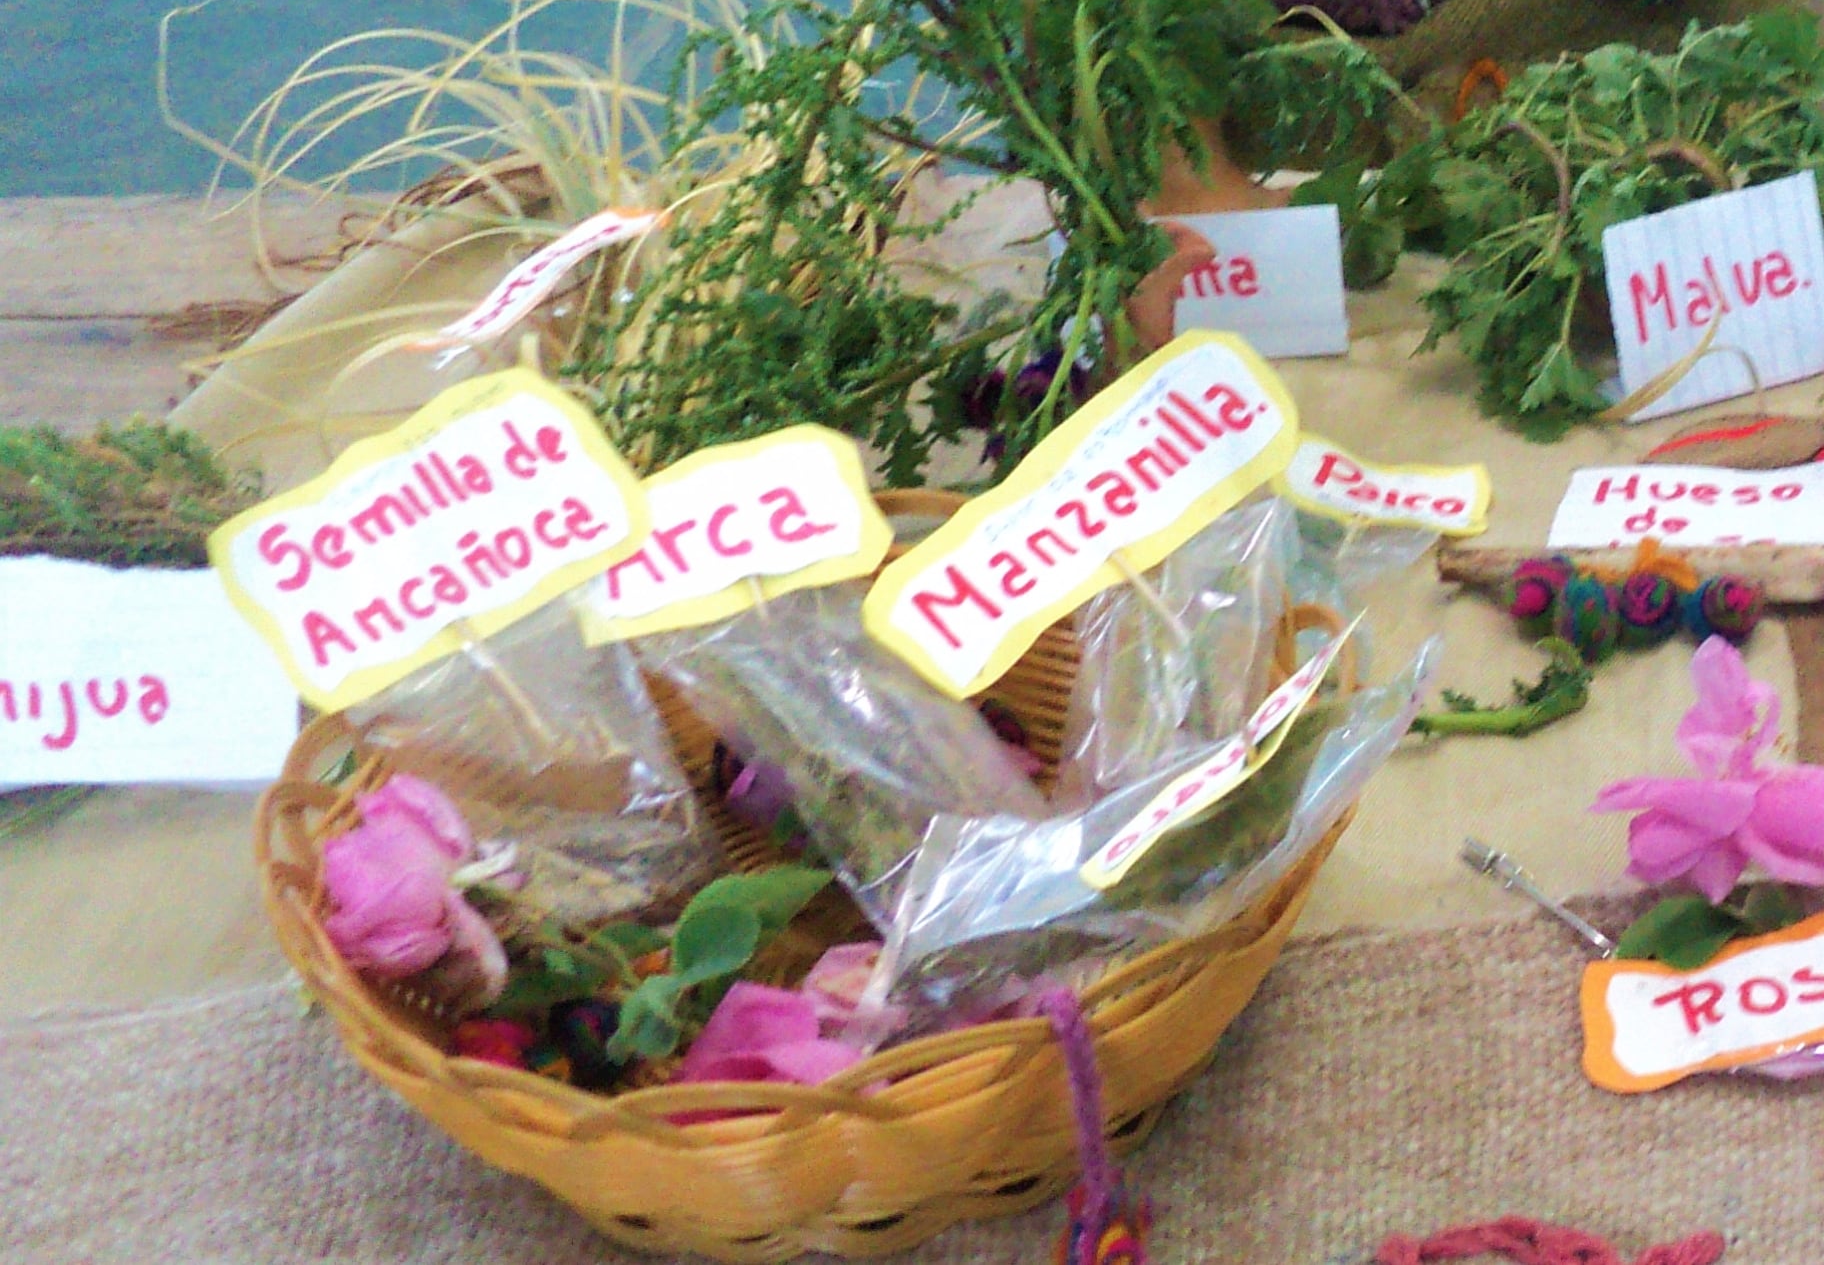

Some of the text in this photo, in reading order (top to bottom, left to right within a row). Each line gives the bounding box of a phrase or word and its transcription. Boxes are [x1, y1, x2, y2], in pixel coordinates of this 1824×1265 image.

[256, 450, 496, 594] Semilla
[500, 419, 569, 481] de
[1311, 450, 1469, 517] Paico
[1592, 473, 1805, 507] Hueso
[1621, 504, 1691, 535] de
